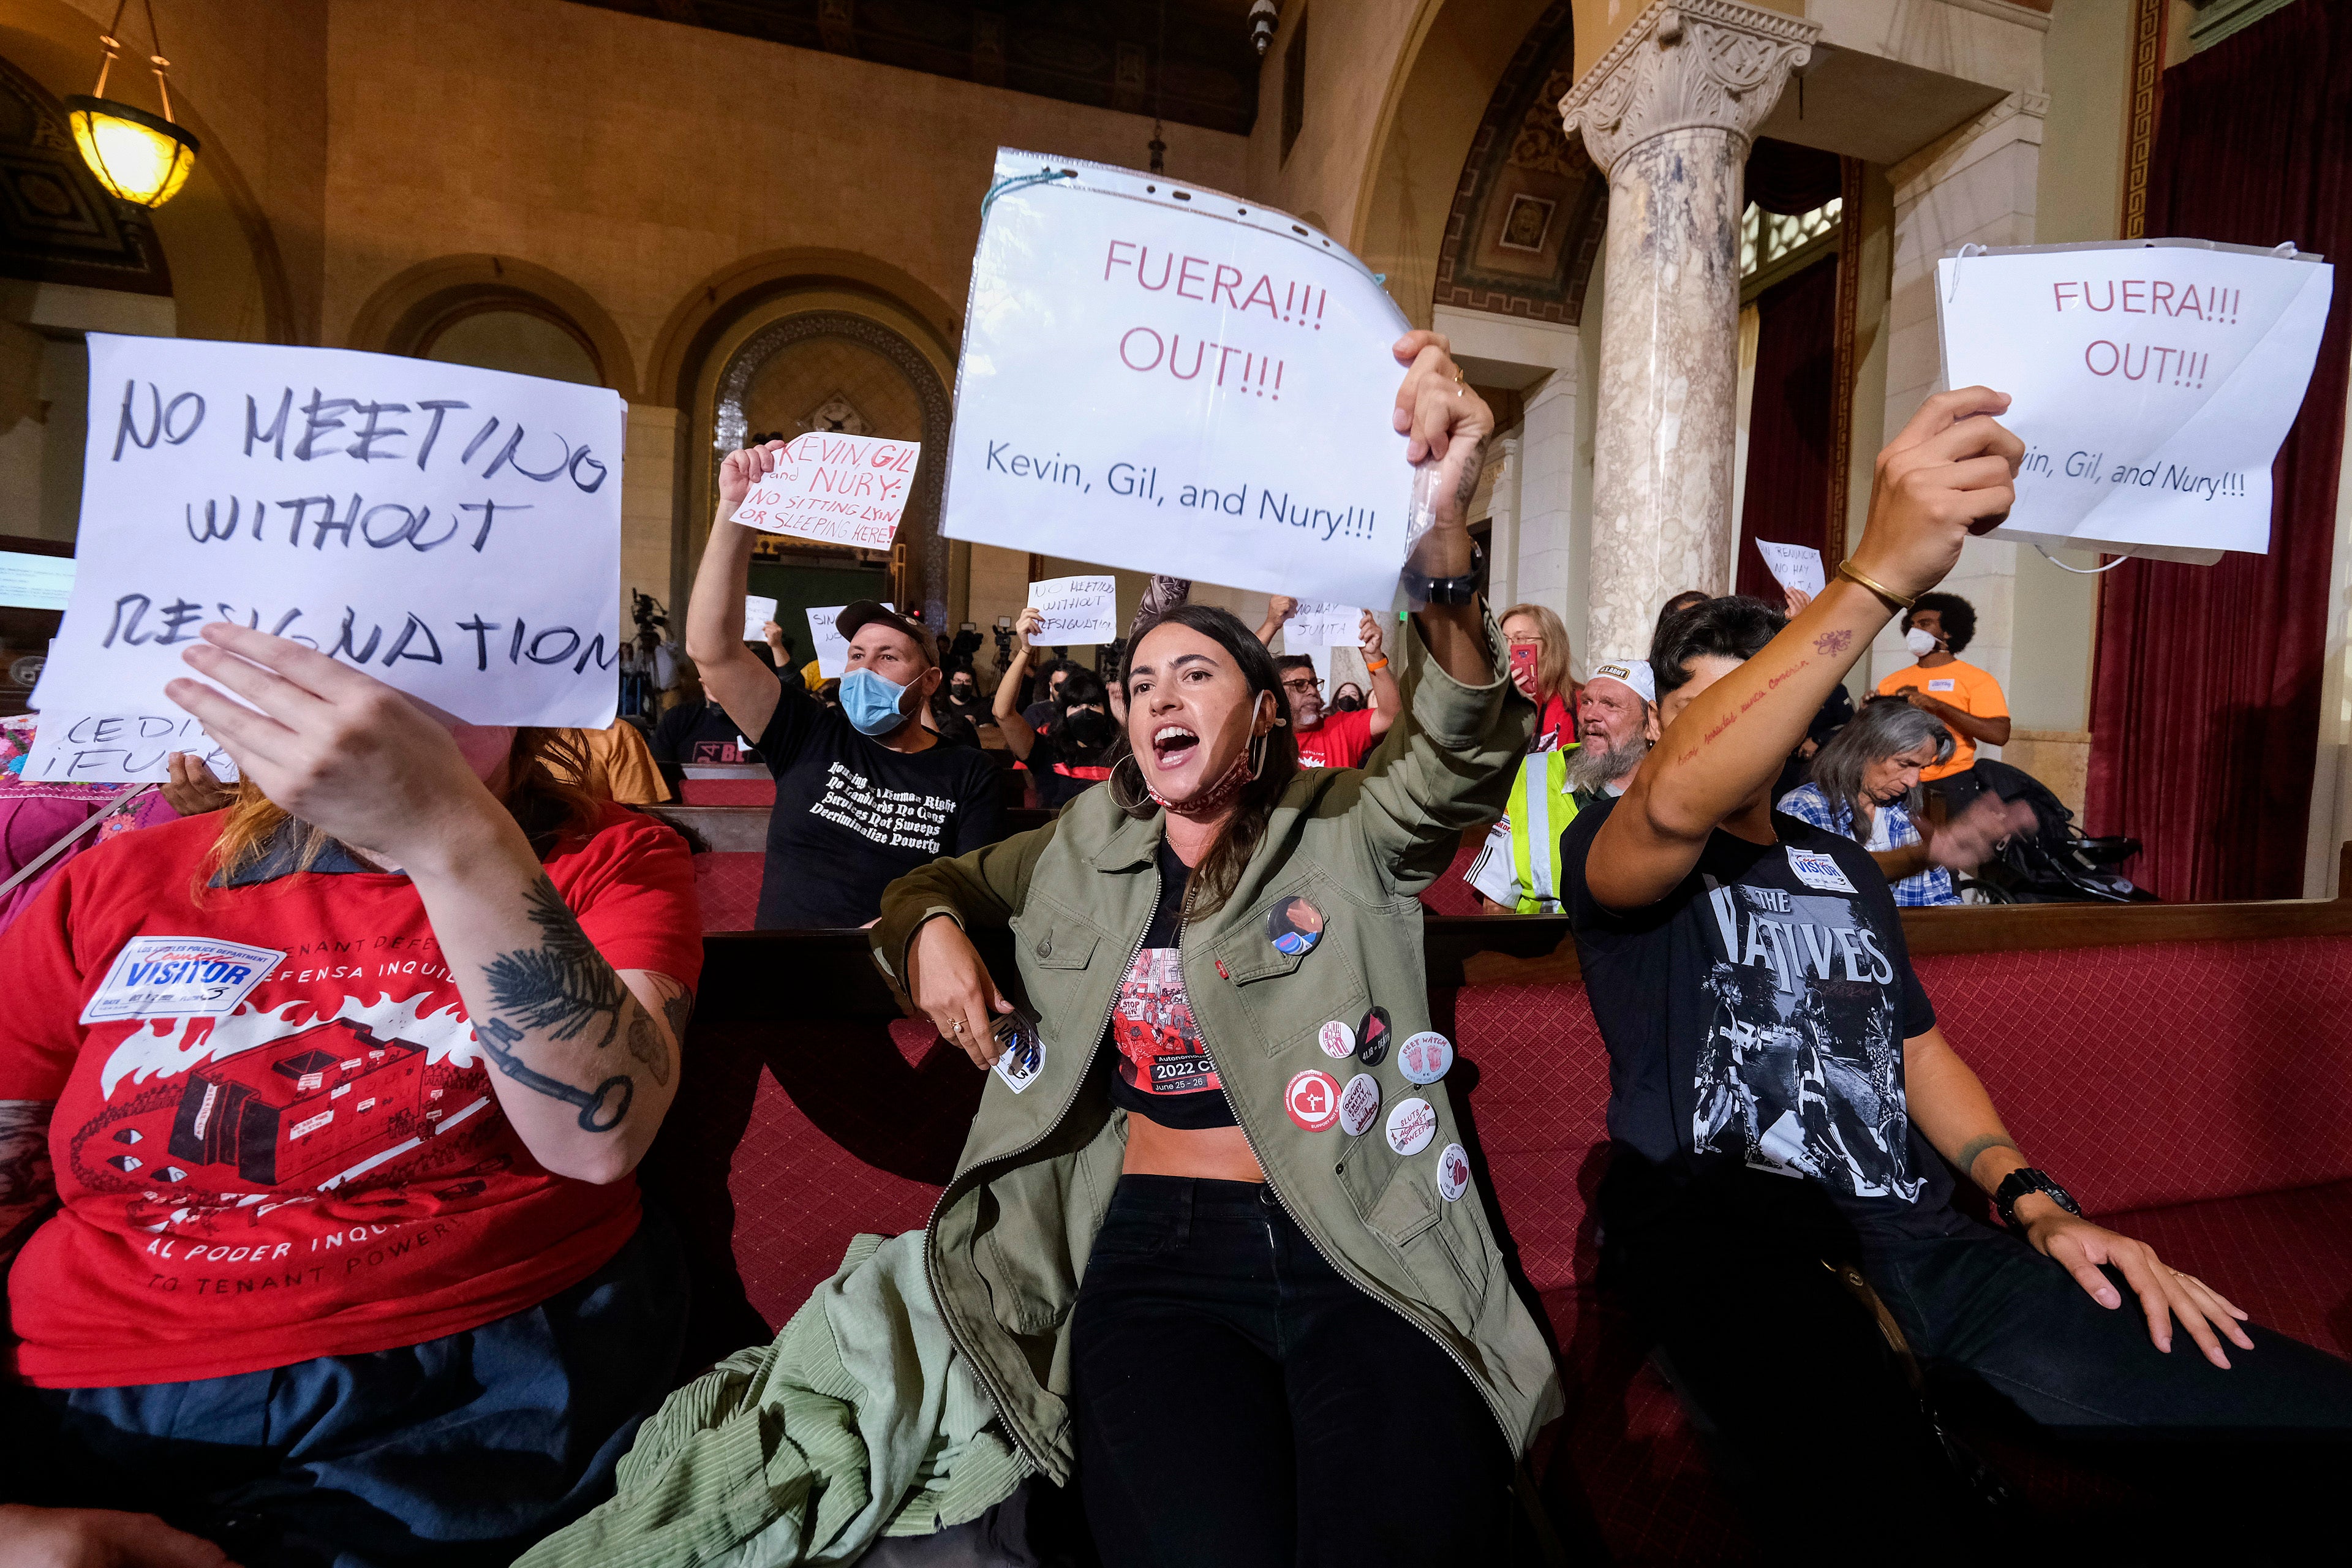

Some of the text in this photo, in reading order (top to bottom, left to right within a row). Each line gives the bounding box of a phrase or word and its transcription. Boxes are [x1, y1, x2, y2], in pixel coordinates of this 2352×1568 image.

[1104, 239, 1327, 330] FUERA!!!
[2053, 279, 2241, 325] FUERA!!!
[1120, 326, 1284, 401] OUT!!!
[2085, 340, 2209, 390] OUT!!!
[112, 380, 607, 493] NO MEETING
[779, 435, 914, 473] KEVIN, GIL
[770, 467, 901, 500] and NURY:
[2065, 450, 2103, 484] Gil,
[2111, 461, 2162, 488] and
[2162, 464, 2245, 501] Nury!!!
[748, 488, 780, 505] NO
[785, 496, 860, 515] SITTING
[987, 440, 1375, 540] Kevin, Gil, and Nury!!!
[187, 492, 533, 552] WITHOUT
[739, 509, 896, 544] OR SLEEPING HERE!
[1774, 563, 1809, 575] NO HAY
[1034, 583, 1063, 598] NO
[1043, 595, 1105, 611] WITHOUT
[813, 614, 835, 625] SIN
[1295, 603, 1339, 616] NO HAY
[826, 632, 842, 642] NO
[1297, 622, 1346, 636] JUNTA
[68, 716, 208, 744] CEDI
[826, 776, 845, 790] No
[843, 785, 894, 815] Landlords
[895, 804, 915, 817] No
[882, 788, 921, 804] Human
[924, 796, 957, 813] Right
[821, 791, 941, 837] Services Not Sweeps
[809, 802, 941, 854] Decriminalize Poverty
[1755, 889, 1792, 913] THE
[217, 948, 268, 963] DEPARTMENT
[270, 938, 366, 958] ENANT
[126, 961, 252, 986] VISITOR
[996, 1023, 1040, 1073] VISITOR
[1378, 1033, 1390, 1049] DEATH
[1403, 1036, 1448, 1055] FEET WATCH
[1156, 1062, 1196, 1080] 2022
[1155, 1082, 1174, 1091] June
[1344, 1080, 1362, 1109] OCCUPY
[1349, 1088, 1365, 1114] EMPTY
[1352, 1091, 1372, 1117] PROPERTY
[1311, 1119, 1330, 1129] SUPPORT
[1400, 1113, 1427, 1138] AGAINST
[1401, 1109, 1419, 1127] SLUTS
[1404, 1121, 1430, 1145] SWEEPS
[146, 1237, 176, 1259] AL
[184, 1241, 293, 1263] PODER
[146, 1273, 178, 1293] TO
[197, 1265, 325, 1295] TENANT
